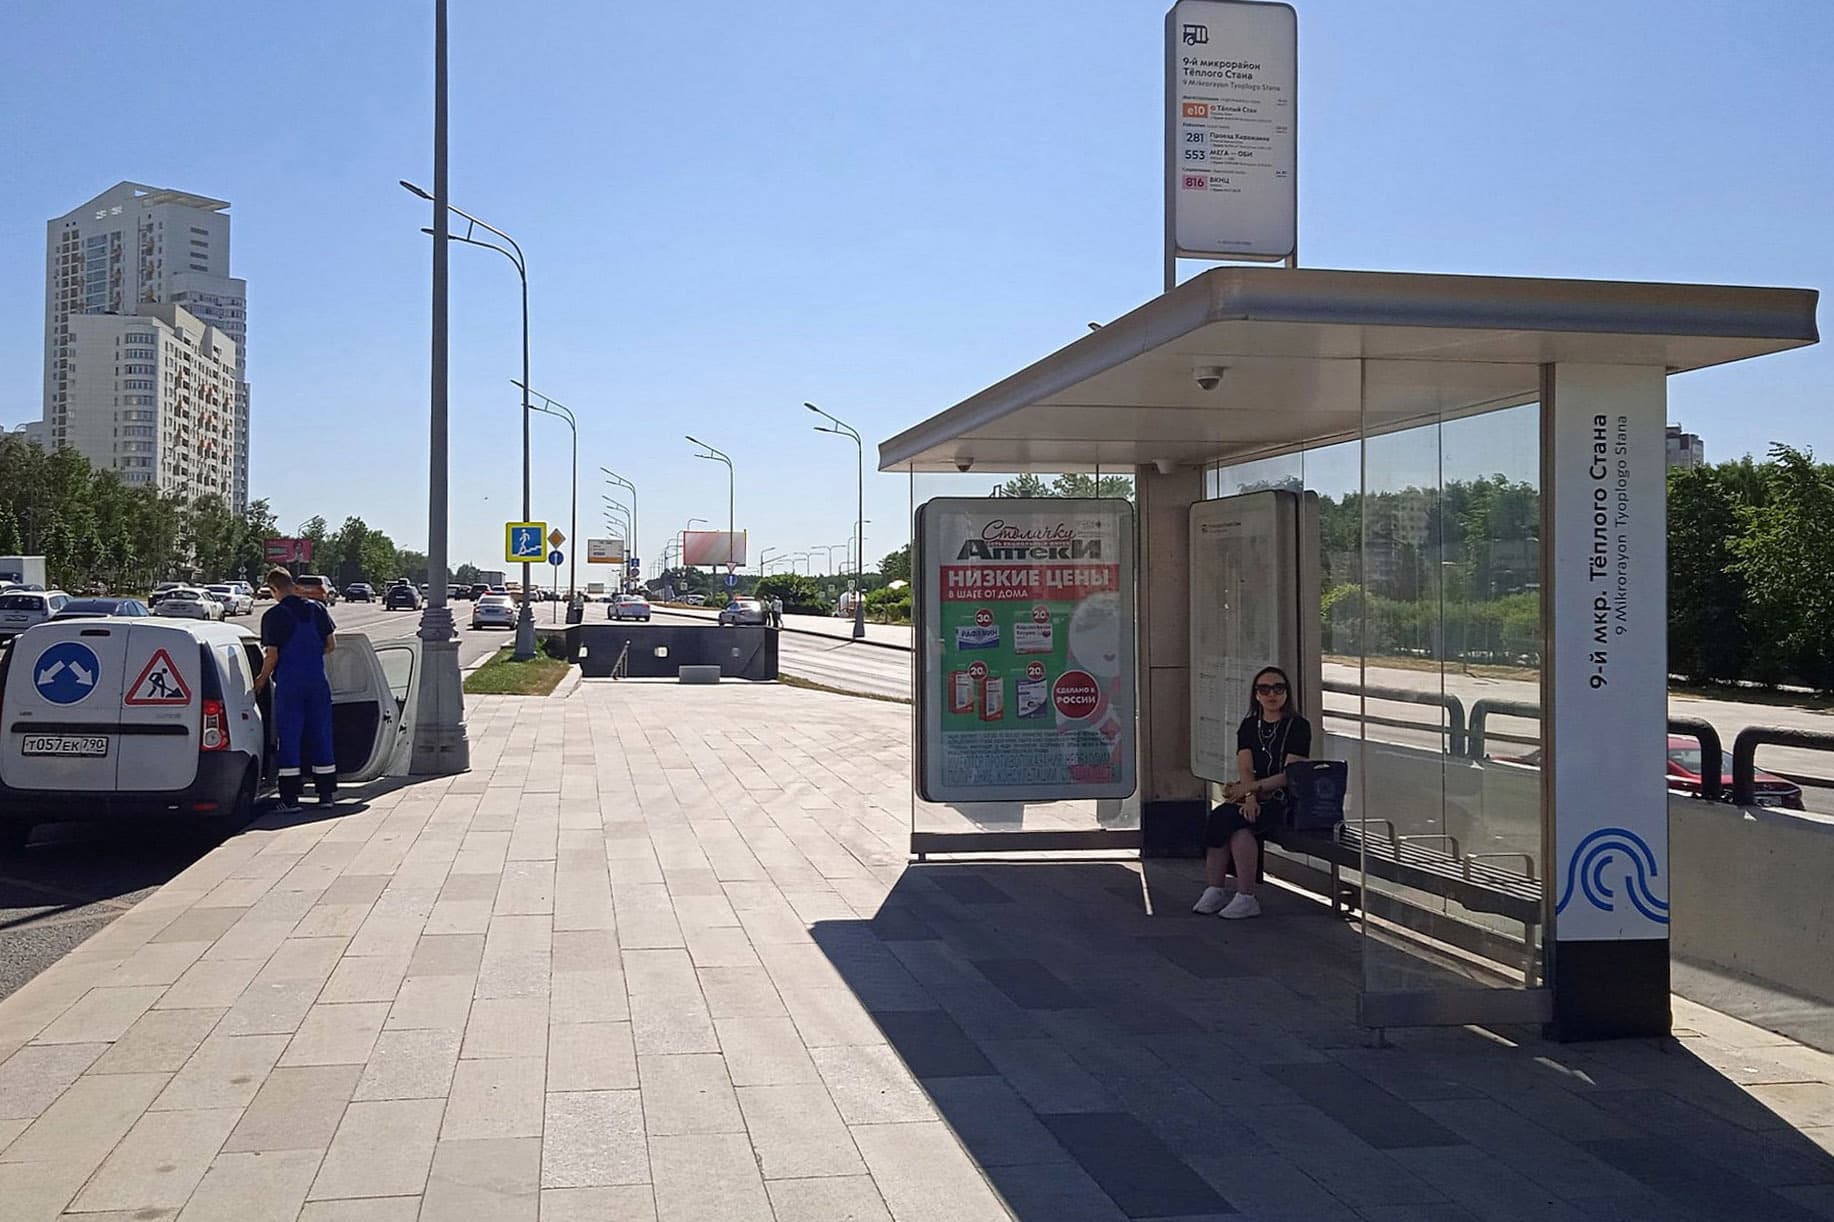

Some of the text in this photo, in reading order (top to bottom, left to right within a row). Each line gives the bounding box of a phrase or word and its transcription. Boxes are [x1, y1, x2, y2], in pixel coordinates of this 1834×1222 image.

[1183, 57, 1260, 70] 9-й микрорайон
[1183, 68, 1253, 80] Тёплого Стана
[1186, 133, 1204, 143] 281
[1185, 150, 1205, 160] 553
[1185, 177, 1204, 187] 816
[981, 519, 1078, 541] Столички
[1615, 415, 1630, 635] 9 Mikrorayon Tyoplogo Stana
[1589, 414, 1611, 689] 9-й мкр. Тёплого Стана
[948, 568, 1109, 588] НИЗКИЕ ЦЕНЫ
[956, 590, 982, 599] ШАГЕ
[985, 589, 998, 598] ОТ
[998, 589, 1028, 599] ДОМА
[1056, 696, 1096, 704] РОССИИ
